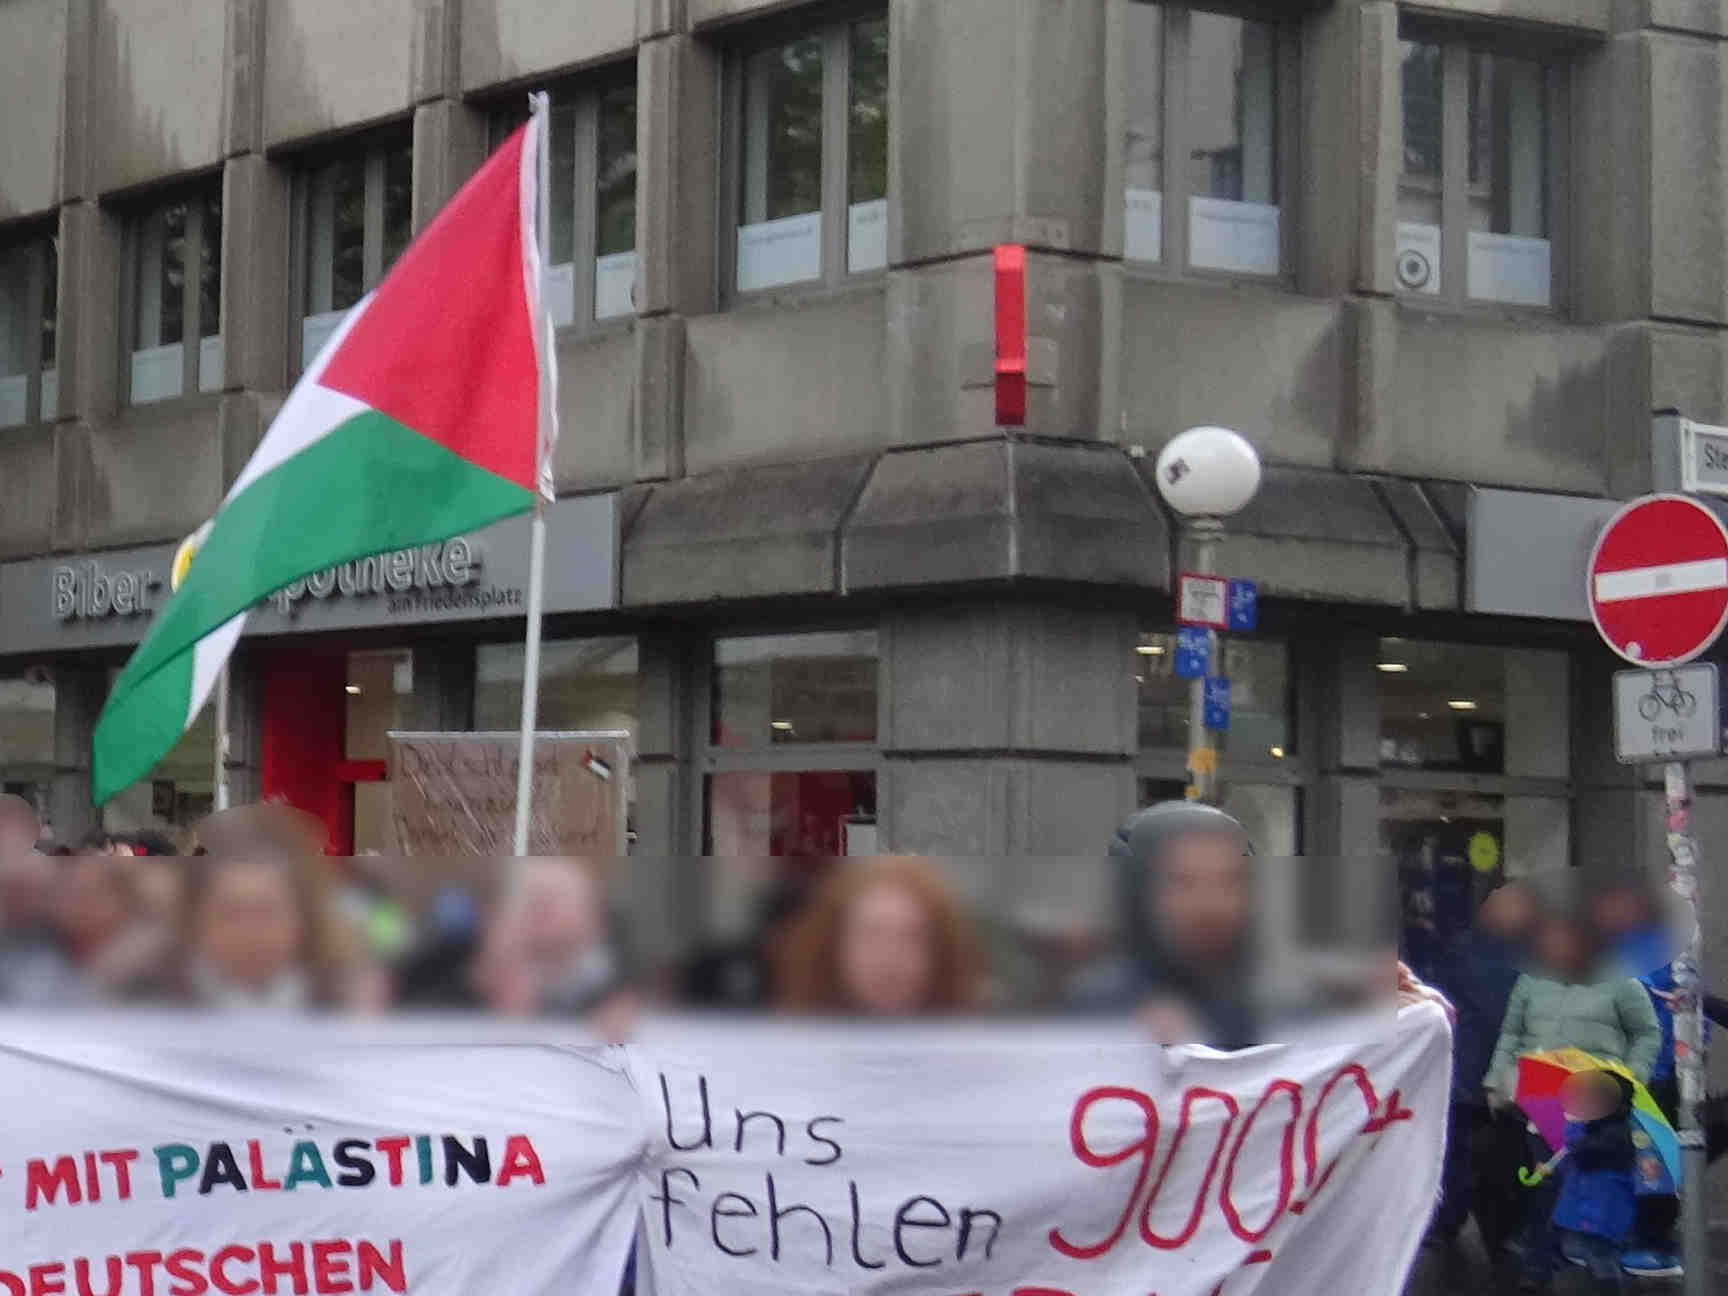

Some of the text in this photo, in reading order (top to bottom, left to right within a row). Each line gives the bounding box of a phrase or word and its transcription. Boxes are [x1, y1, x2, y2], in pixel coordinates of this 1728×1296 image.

[268, 536, 473, 615] potheke
[1650, 723, 1685, 744] frei
[658, 1071, 846, 1167] Uns
[25, 1149, 138, 1211] MIT
[152, 1125, 546, 1199] PALÄSTINA
[649, 1166, 1003, 1270] fehlen
